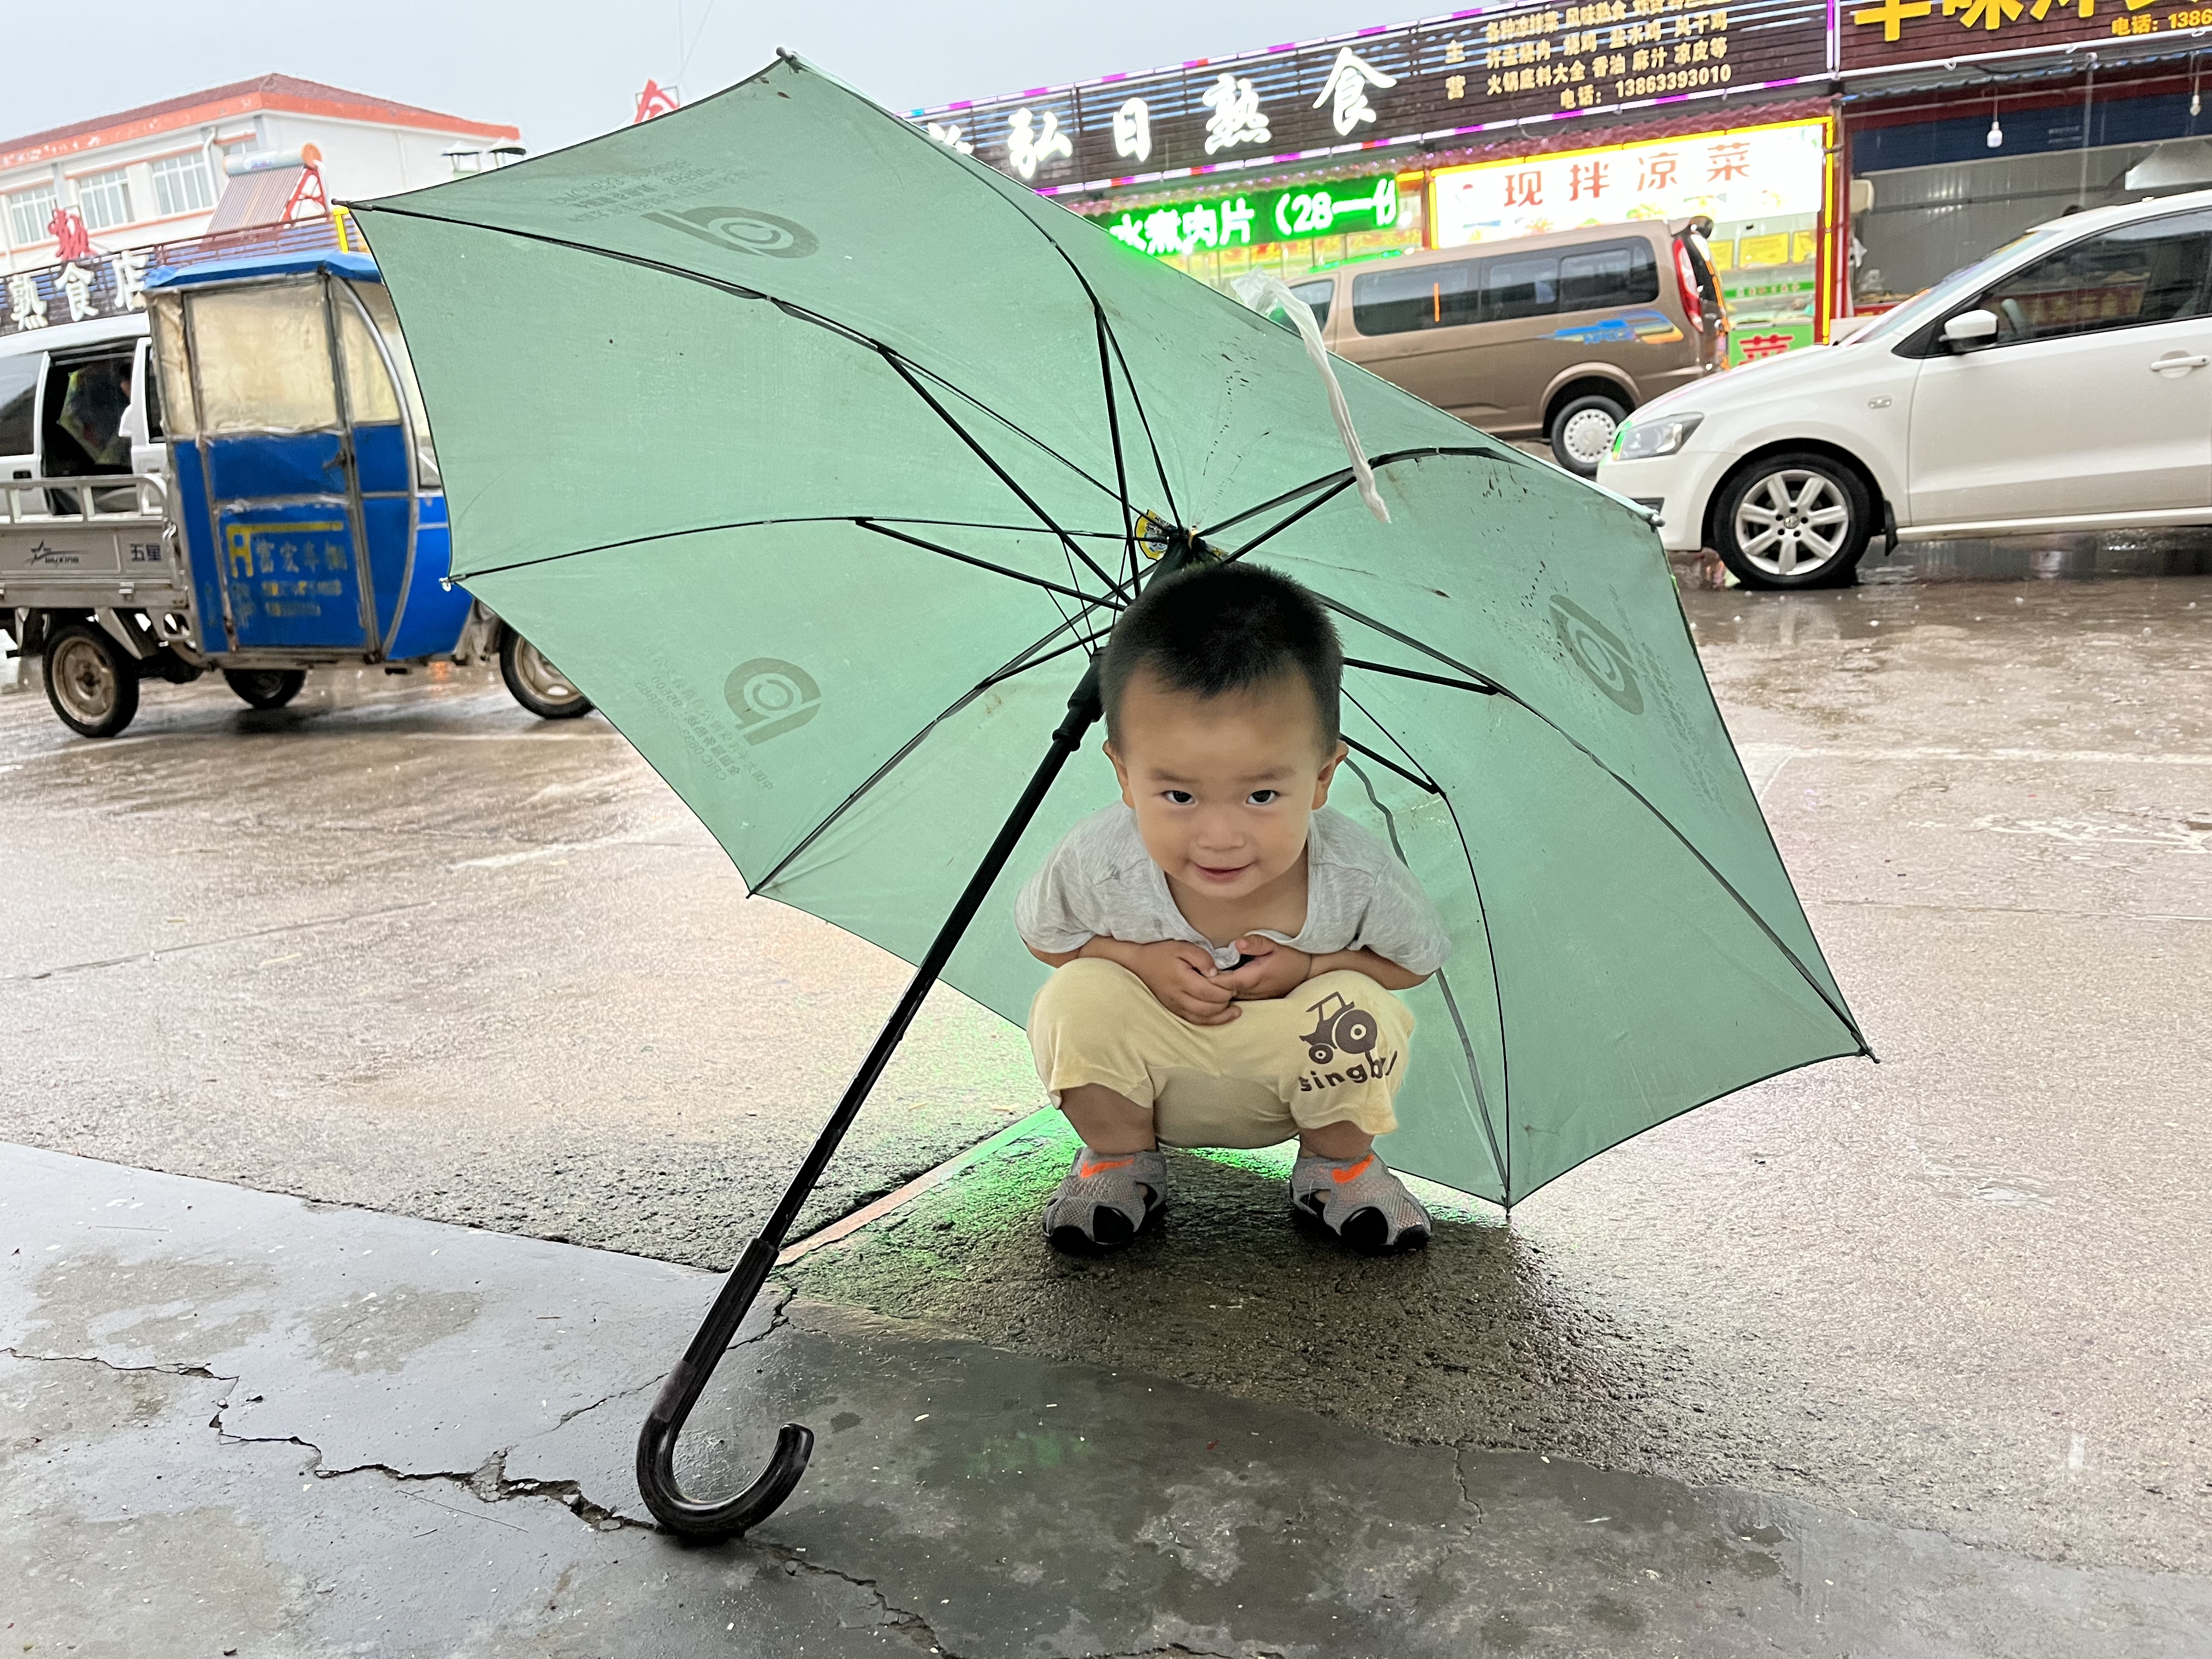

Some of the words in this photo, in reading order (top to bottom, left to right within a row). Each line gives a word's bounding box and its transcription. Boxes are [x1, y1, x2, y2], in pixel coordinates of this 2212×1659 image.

[1445, 40, 1466, 100] 主营
[1487, 60, 1585, 96] 火锅底料大全
[1592, 53, 1626, 78] 香油
[1632, 46, 1667, 71] 麻汁
[1615, 64, 1731, 98] 13863393010
[927, 47, 1397, 178] 弘日熟食
[1504, 143, 1751, 207] 现拌凉菜
[8, 250, 149, 330] 熟食店
